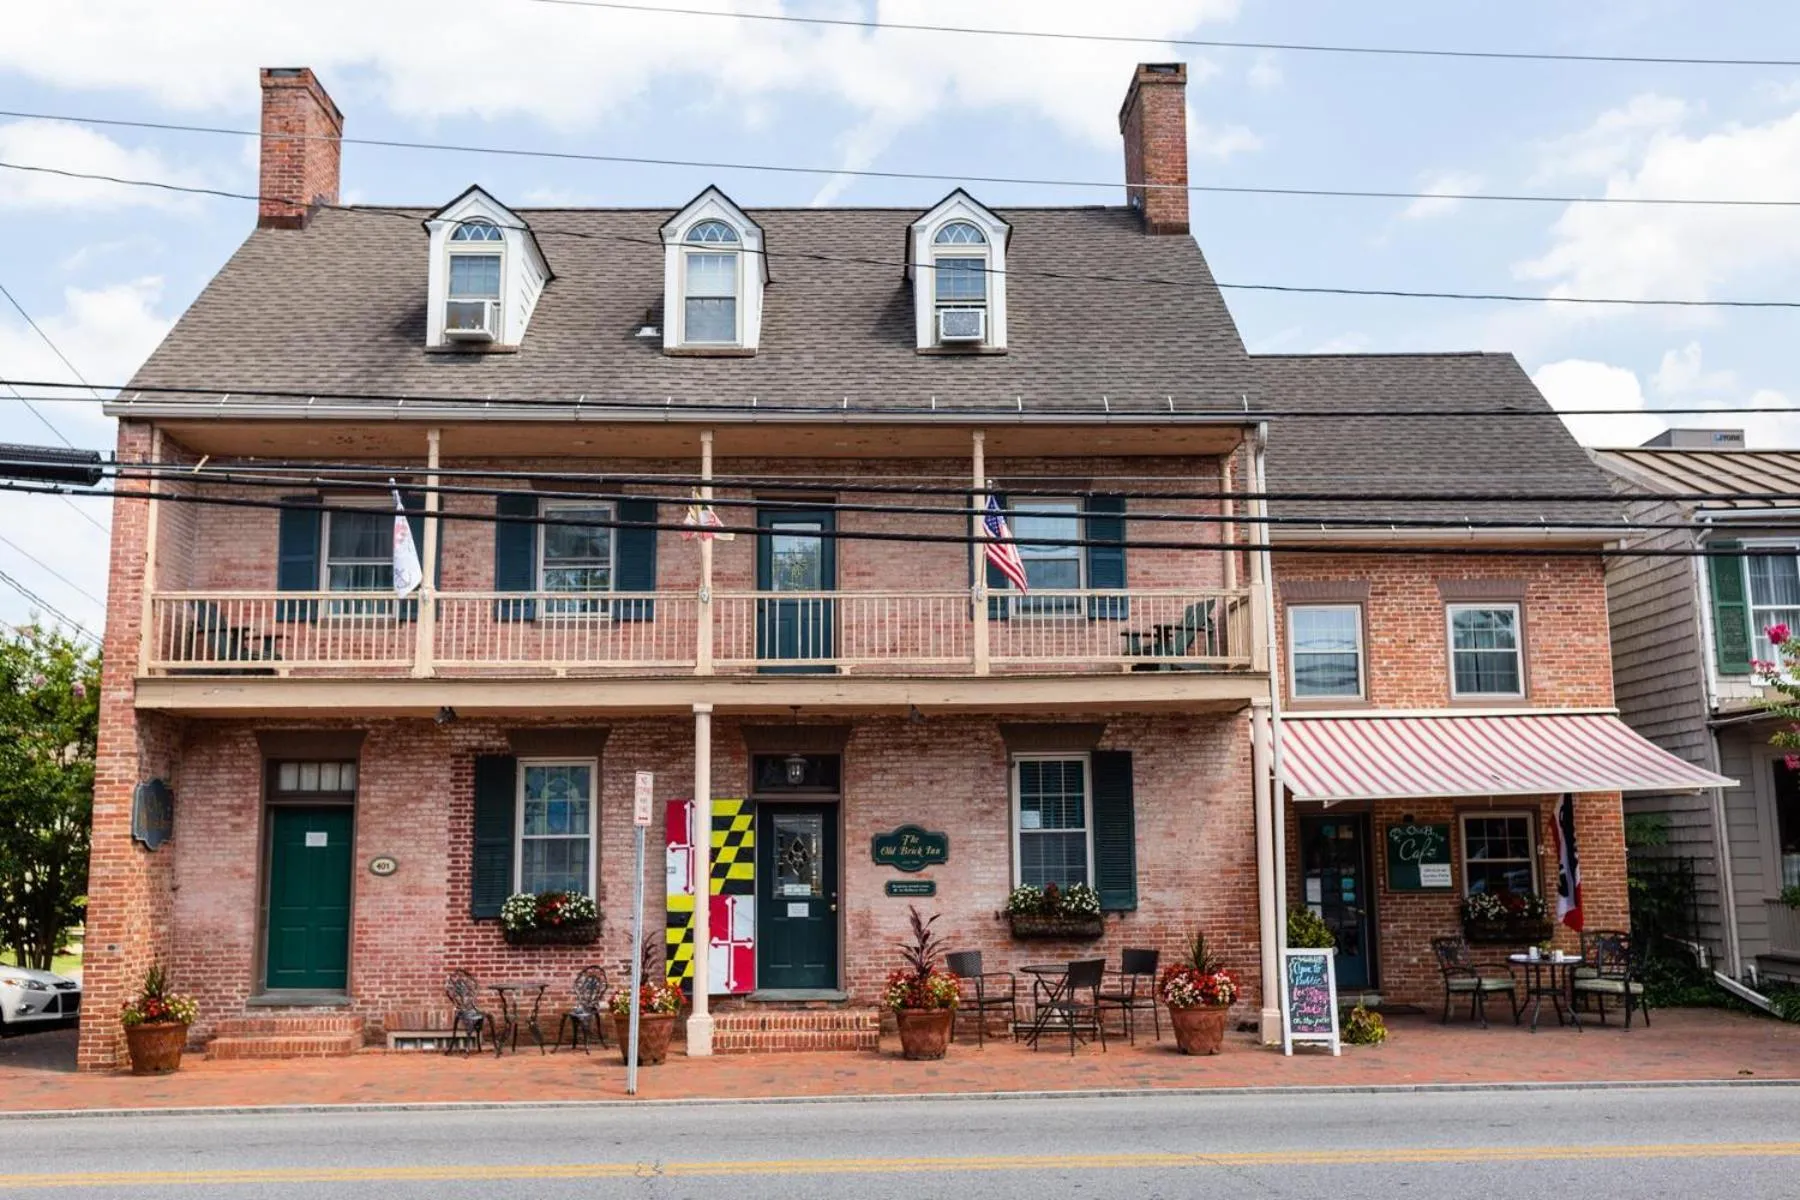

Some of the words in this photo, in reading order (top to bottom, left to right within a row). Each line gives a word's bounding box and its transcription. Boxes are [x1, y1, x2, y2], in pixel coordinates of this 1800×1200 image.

[903, 834, 920, 846] The
[880, 846, 896, 856] Old
[900, 846, 924, 857] Brick
[925, 845, 941, 856] Inn
